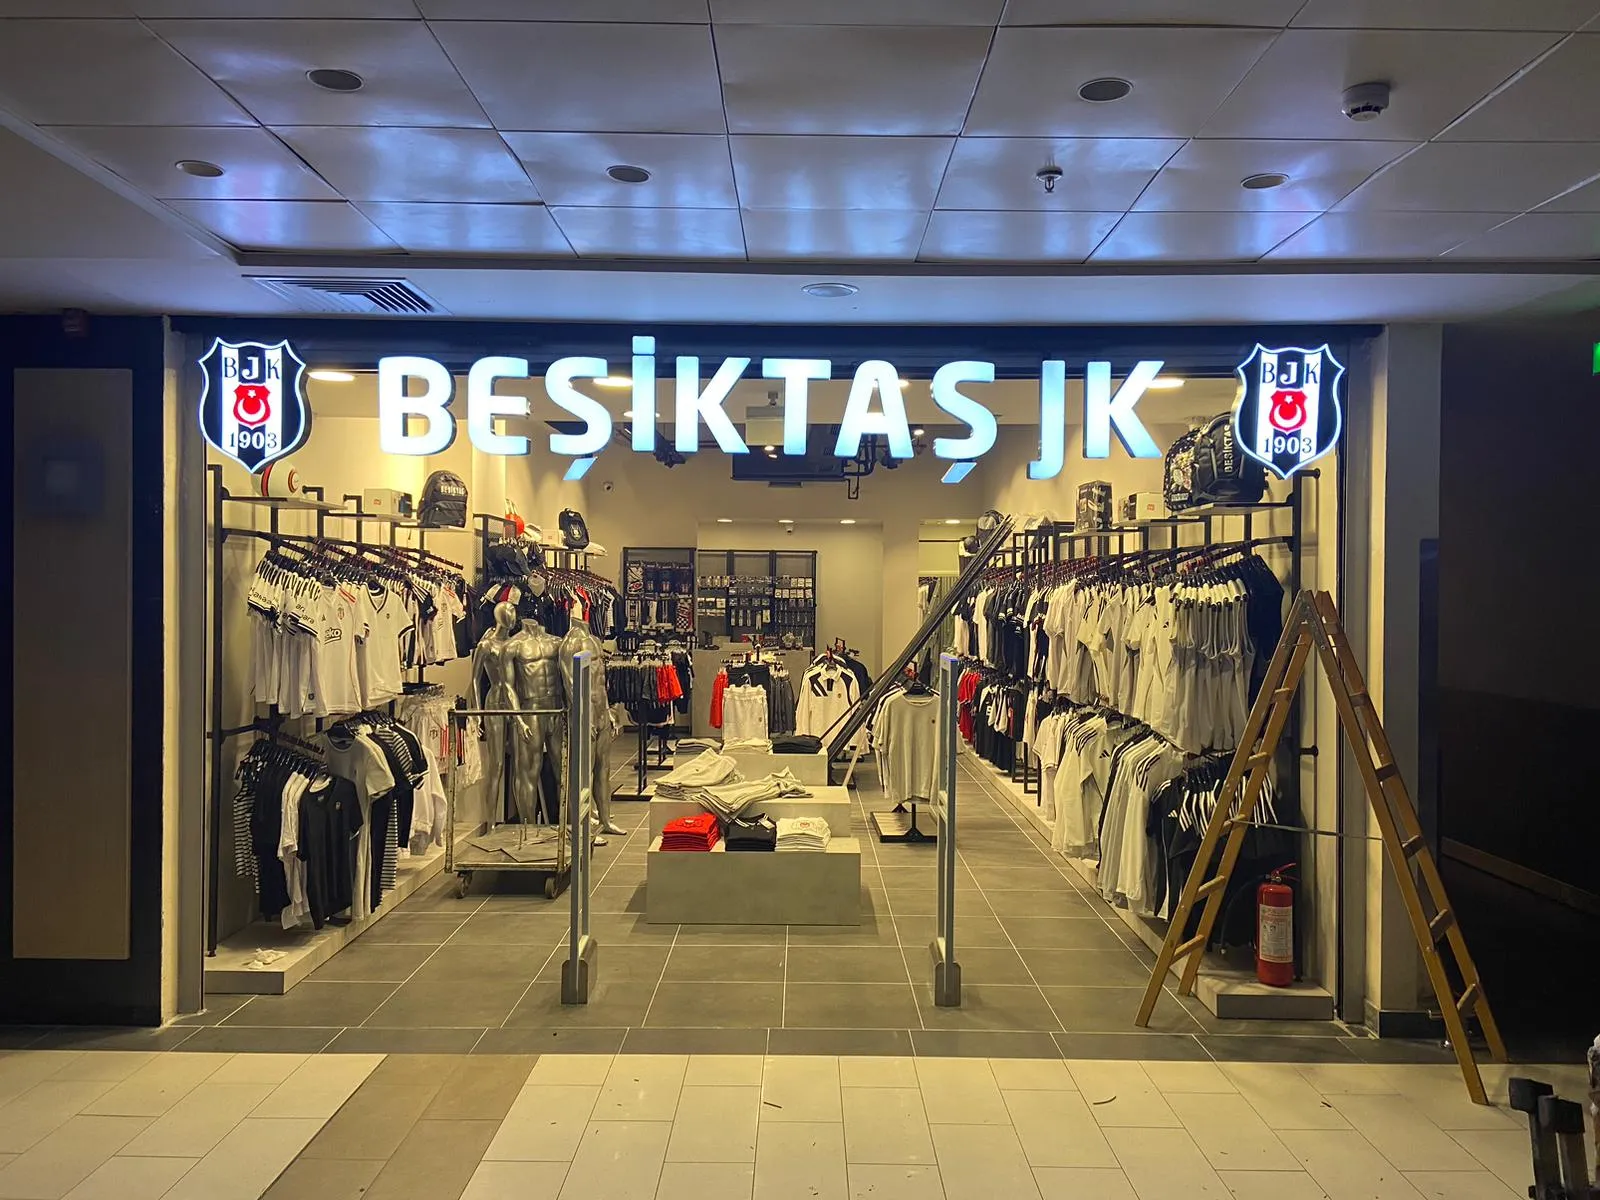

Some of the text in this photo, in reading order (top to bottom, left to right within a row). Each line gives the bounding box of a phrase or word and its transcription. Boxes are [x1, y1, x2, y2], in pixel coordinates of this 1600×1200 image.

[379, 335, 1165, 484] BEŞİKTAŞ JK
[229, 431, 278, 449] 1903
[1263, 436, 1312, 454] 1903
